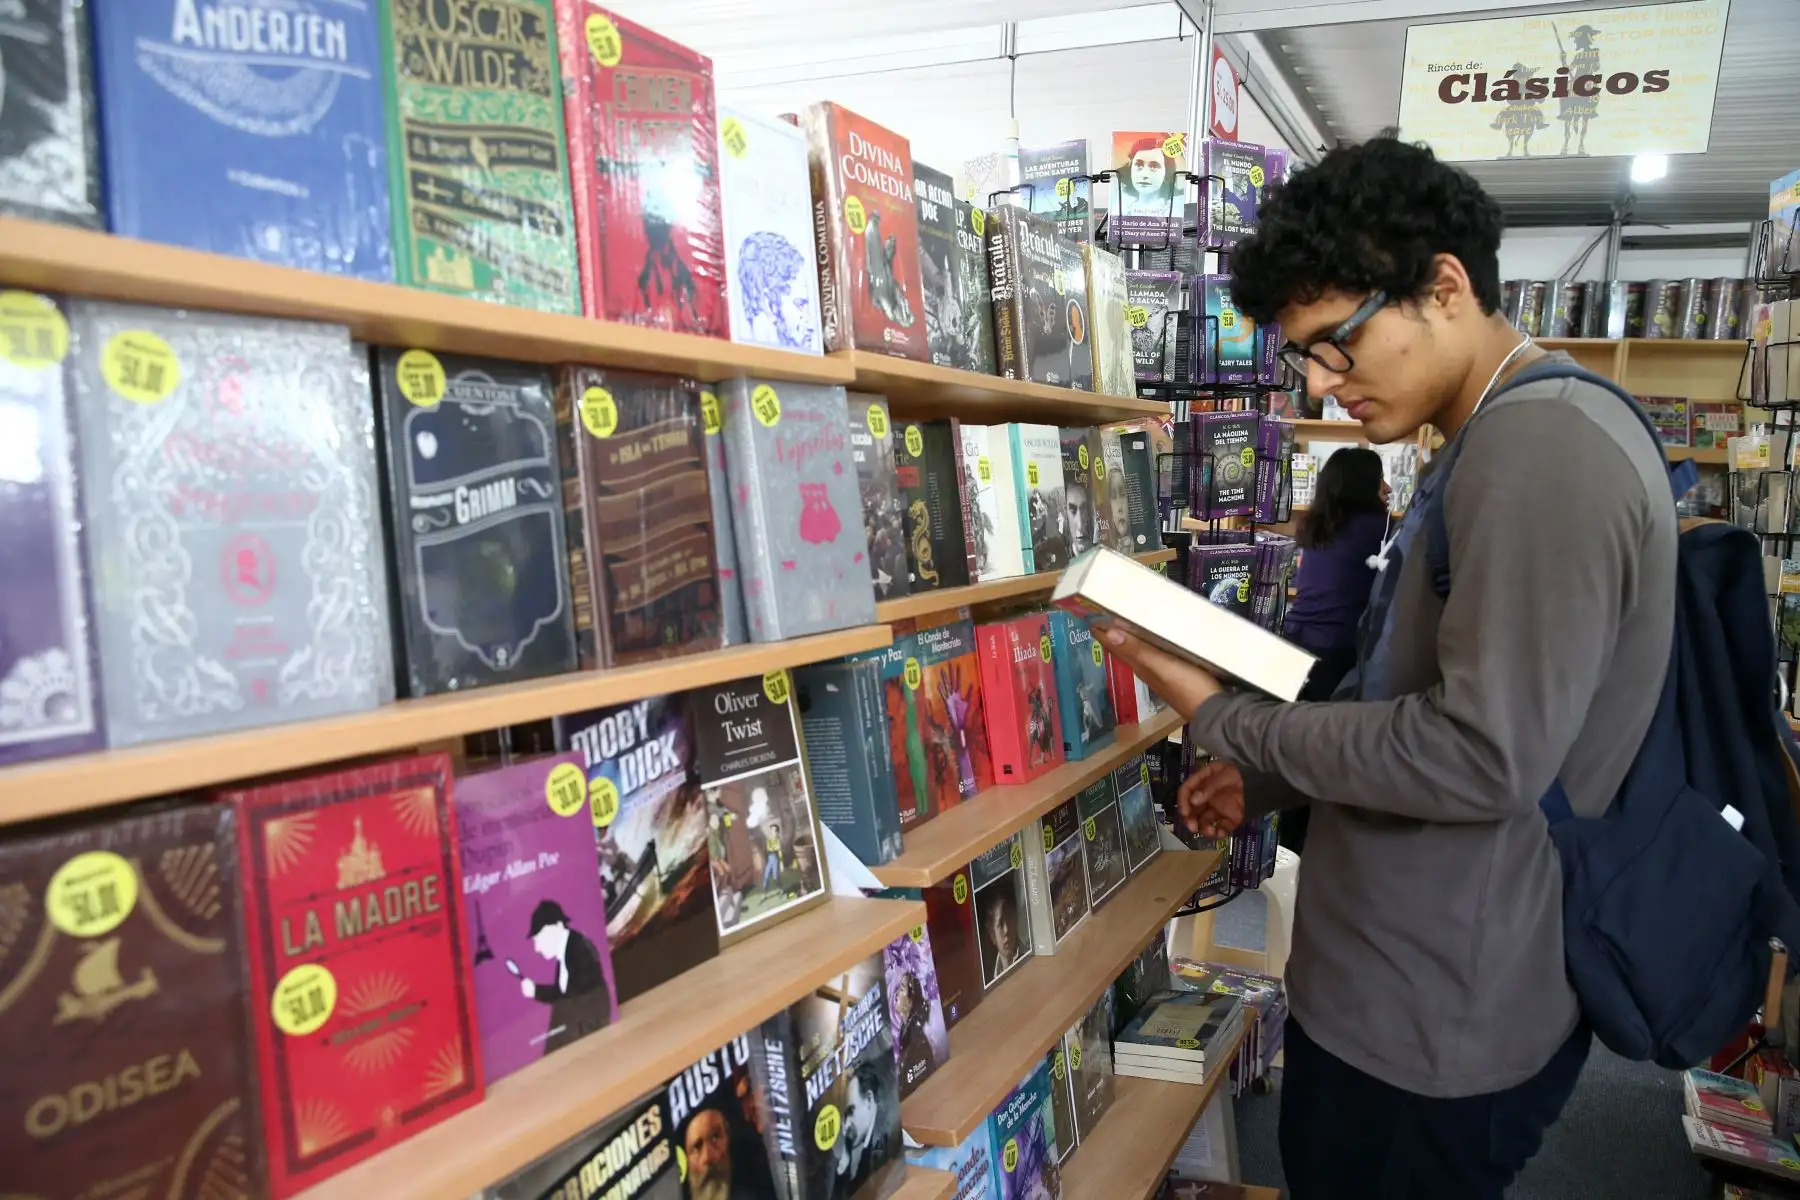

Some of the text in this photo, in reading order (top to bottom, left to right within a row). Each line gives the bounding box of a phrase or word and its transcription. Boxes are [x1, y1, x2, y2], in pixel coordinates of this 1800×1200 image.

[172, 0, 349, 61] ANDERSEN
[425, 0, 528, 45] OSCAR
[418, 36, 519, 89] WILDE
[1427, 61, 1483, 73] Rincón de:
[1438, 67, 1670, 105] Clásicos
[848, 131, 904, 177] DIVINA
[1025, 159, 1079, 173] LAS AVENTURAS
[1230, 160, 1252, 169] MUNDO
[842, 154, 914, 204] COMEDIA
[1051, 166, 1080, 176] SAWYER
[1129, 290, 1165, 298] LLAMADA
[1136, 297, 1169, 305] SALVAJE
[1215, 437, 1248, 446] DEL TIEMPO
[1222, 429, 1249, 438] MÁQUINA
[454, 477, 518, 525] GRIMM
[1218, 494, 1245, 503] MACHINE
[917, 628, 950, 645] El Conde de
[931, 637, 962, 654] Montecristo
[887, 648, 903, 663] Paz
[714, 691, 760, 715] Oliver
[570, 699, 649, 769] MOBY
[721, 717, 763, 743] Twist
[618, 730, 681, 796] DICK
[503, 859, 537, 881] Allan
[281, 874, 442, 956] LA MADRE
[804, 1004, 885, 1113] NIETZSCHE
[23, 1048, 202, 1139] ODISEA
[765, 1038, 797, 1157] NIETZSCHE
[1019, 1091, 1038, 1115] Mancha
[997, 1091, 1026, 1126] Don Quijote
